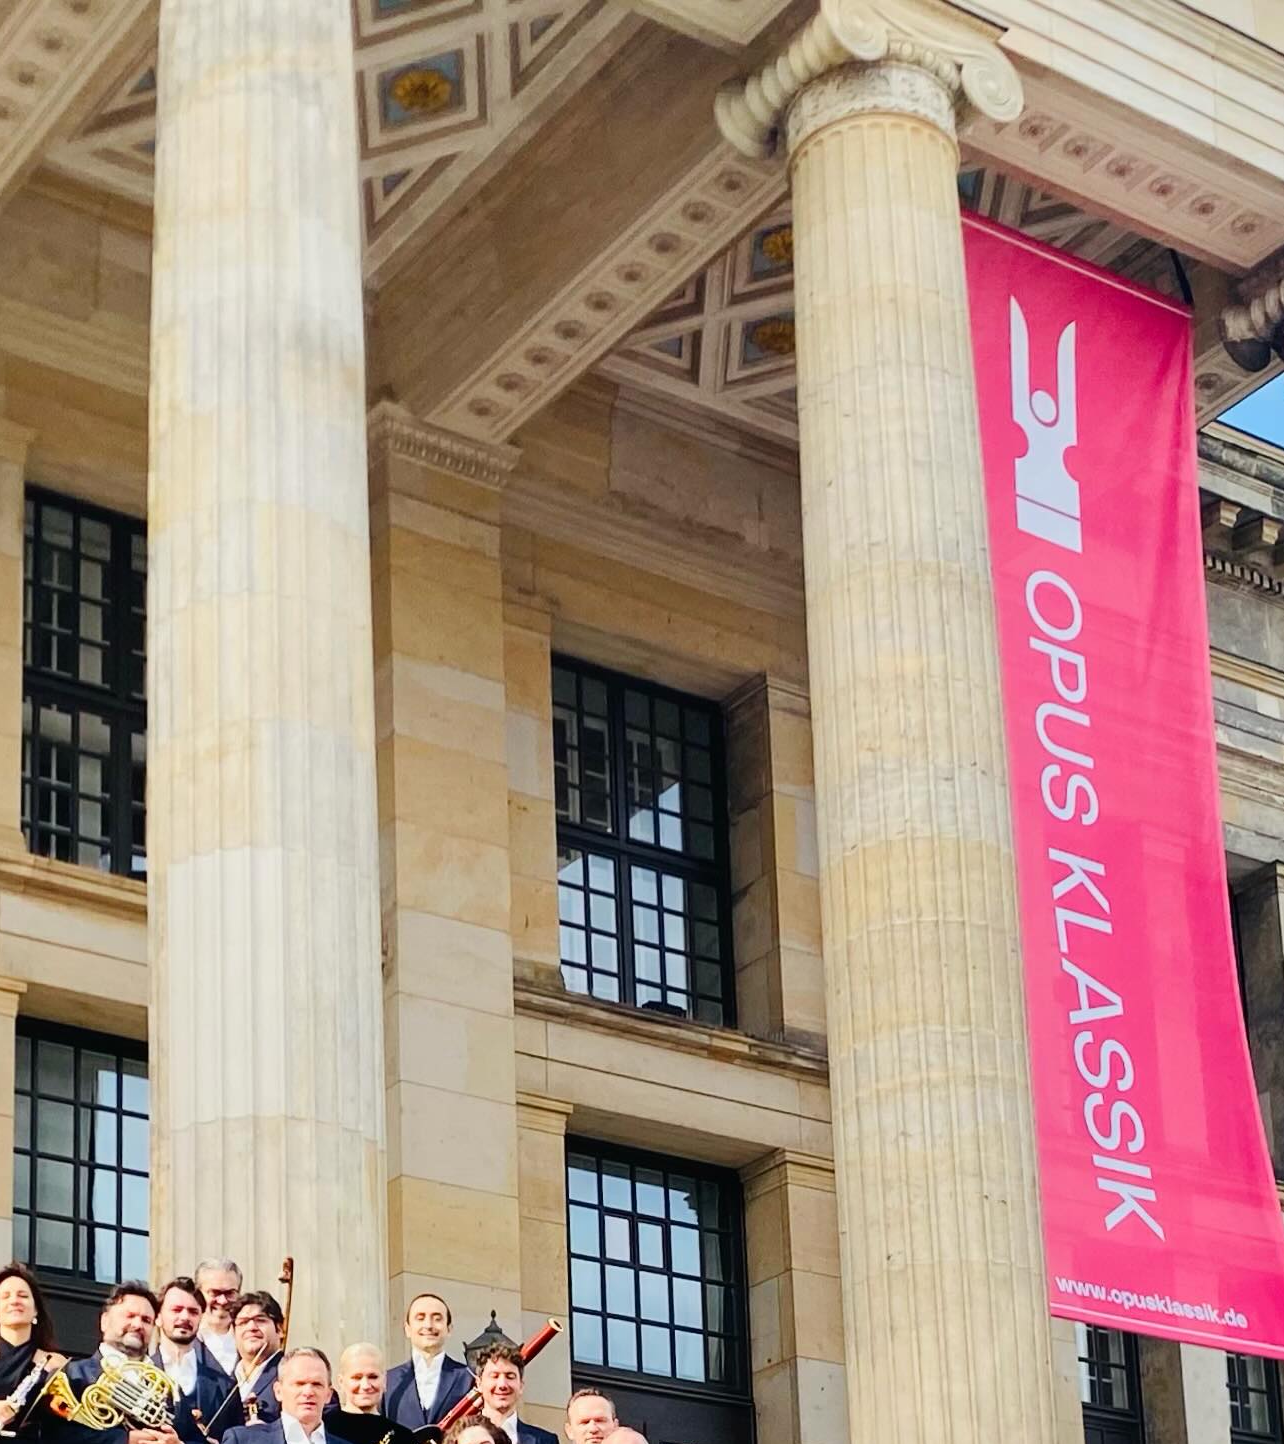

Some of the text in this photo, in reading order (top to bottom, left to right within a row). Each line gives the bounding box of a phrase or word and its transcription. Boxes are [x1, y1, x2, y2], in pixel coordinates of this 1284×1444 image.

[1025, 569, 1166, 1242] OPUS KLASSIK
[1055, 1275, 1249, 1329] www.opusklassik.de
